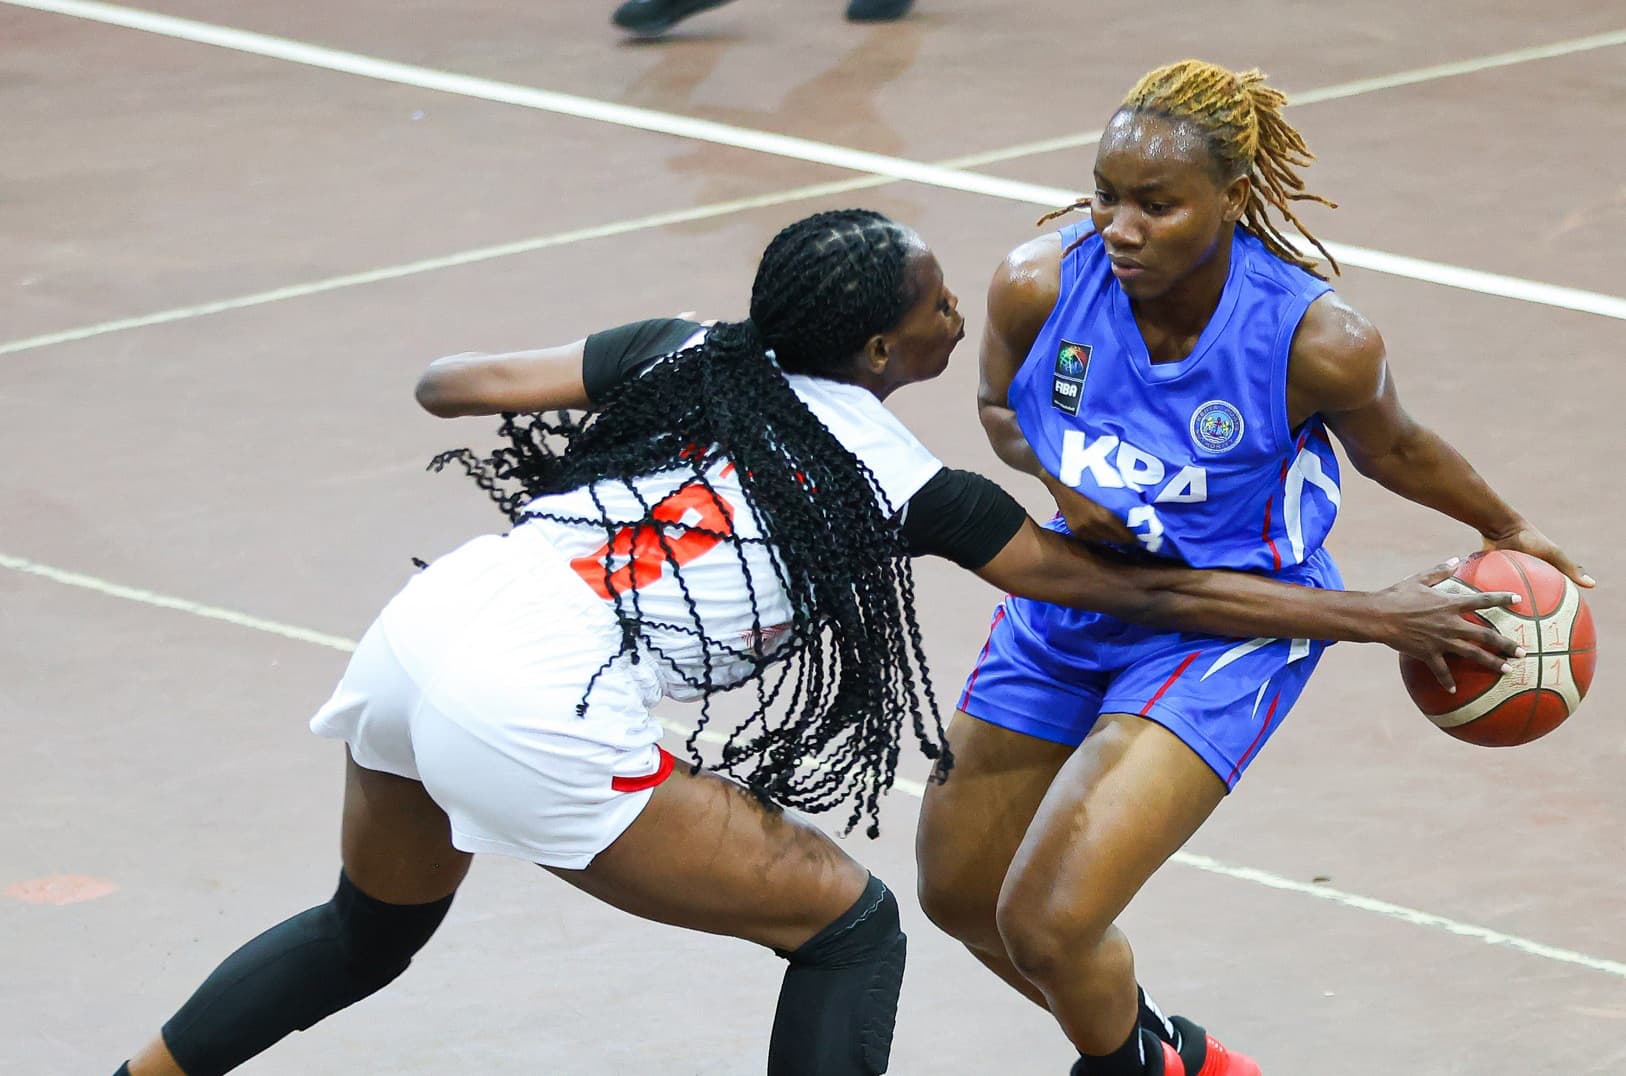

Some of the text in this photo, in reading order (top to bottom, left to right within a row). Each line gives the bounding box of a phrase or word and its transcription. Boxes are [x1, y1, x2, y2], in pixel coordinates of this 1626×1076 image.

[1055, 380, 1077, 398] FIBA
[1059, 430, 1207, 502] KPA
[570, 483, 735, 600] 8
[1514, 622, 1563, 647] 1 1
[1550, 657, 1561, 686] 1
